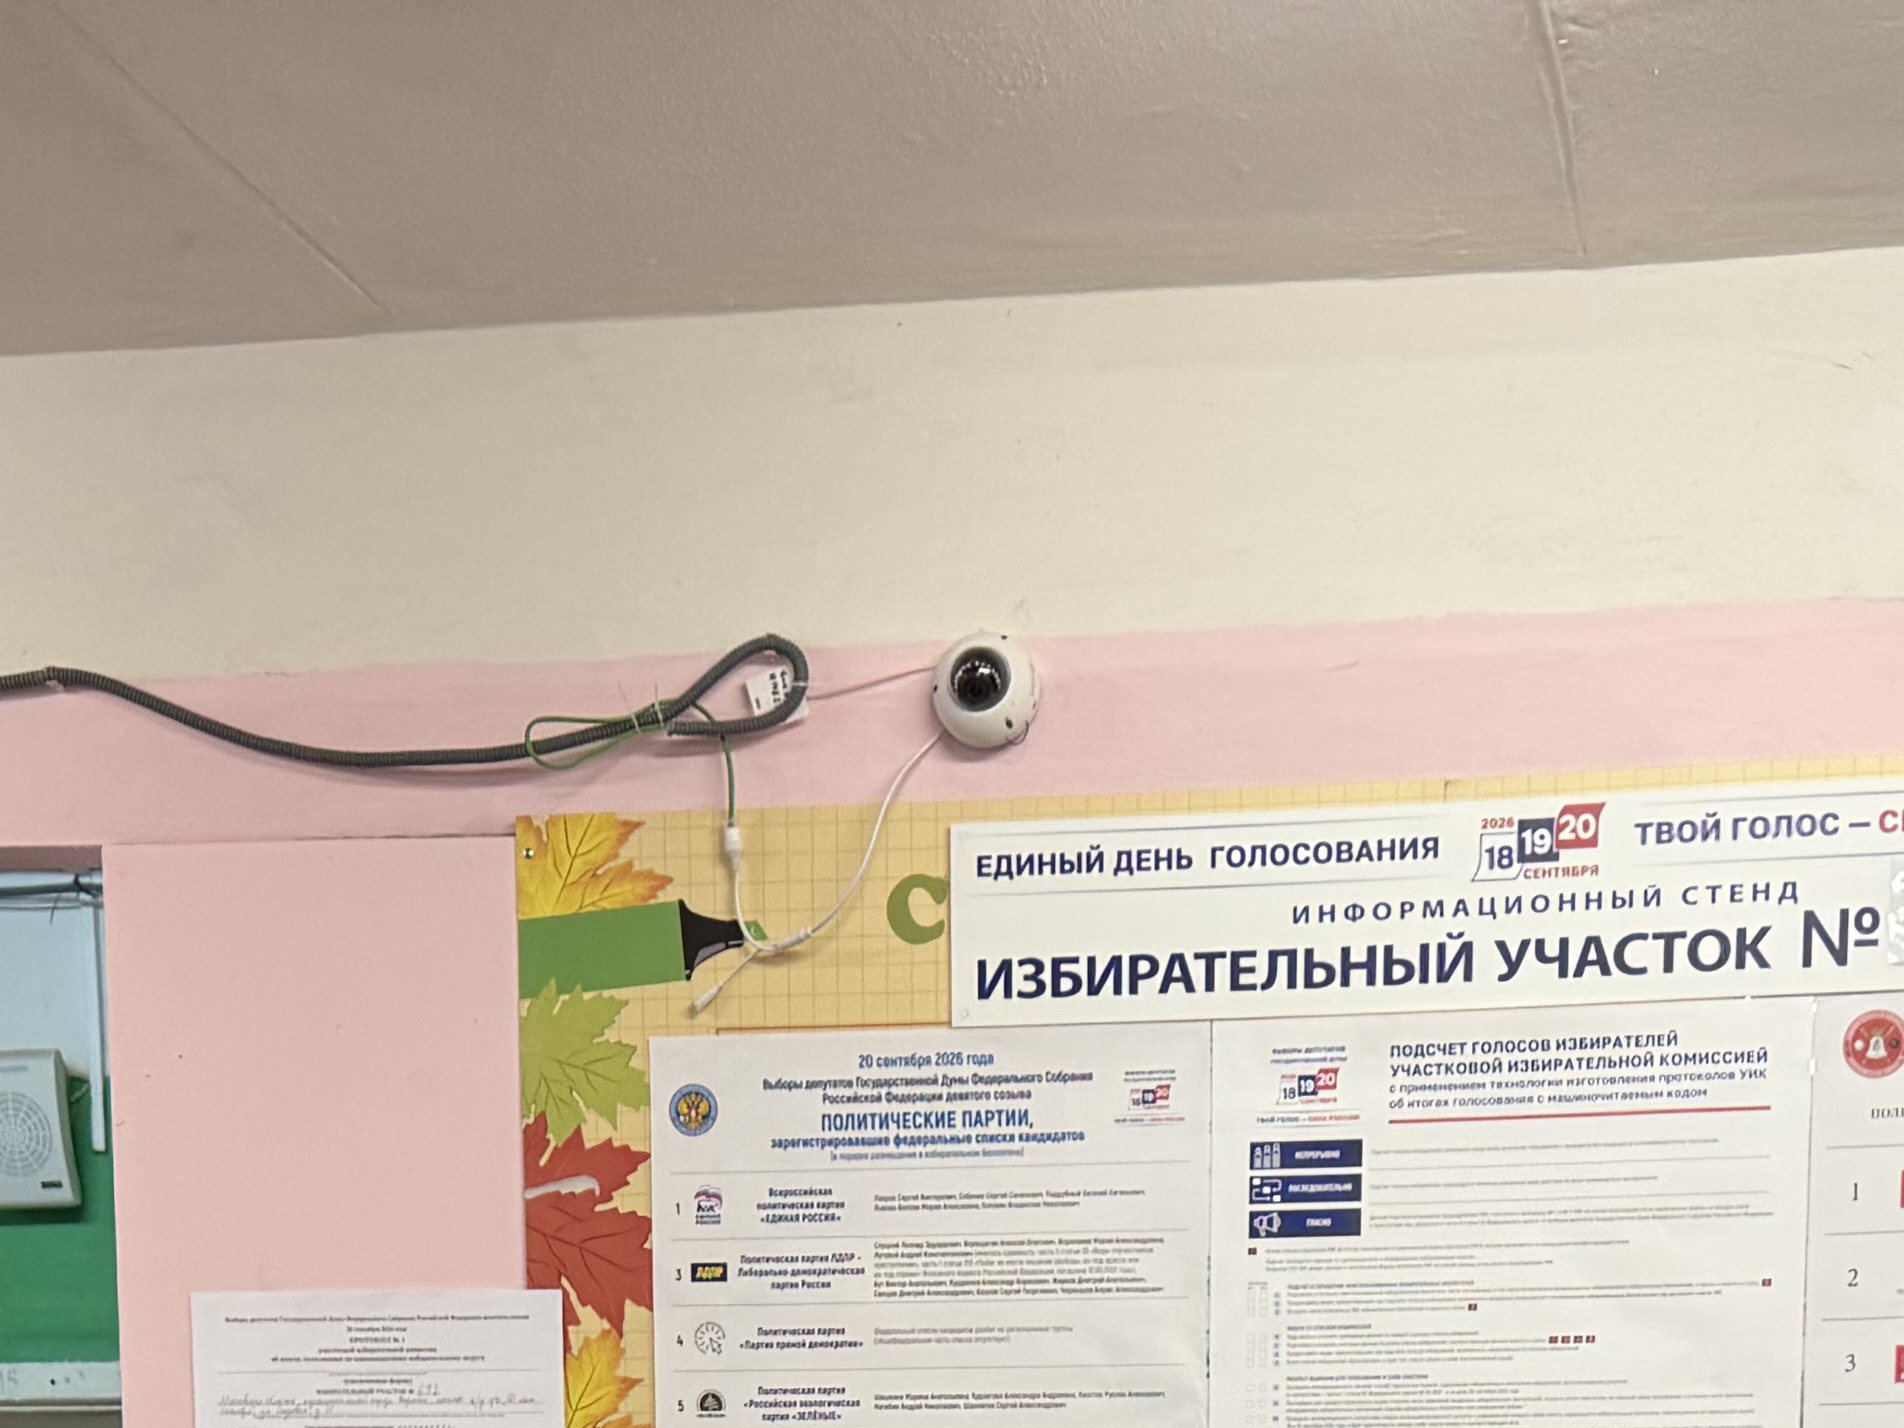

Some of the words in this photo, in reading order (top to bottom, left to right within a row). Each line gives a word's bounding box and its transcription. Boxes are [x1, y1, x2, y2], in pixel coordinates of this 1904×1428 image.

[1481, 817, 1515, 831] 2026
[1633, 812, 1720, 844] ТВОЙ
[1731, 812, 1839, 839] ГОЛОС
[1485, 843, 1514, 872] 18
[1520, 829, 1552, 856] 19
[1557, 812, 1596, 840] 20
[976, 845, 1104, 880] ЕДИНЫЙ
[1112, 848, 1193, 876] ДЕНЬ
[1210, 837, 1438, 867] ГОЛОСОВАНИЯ
[1523, 864, 1599, 881] СЕНТЯБРЯ
[1292, 886, 1661, 924] ИНФОРМАЦИОННЫЙ
[1681, 880, 1799, 907] СТЕНД
[976, 931, 1474, 1001] ИЗБИРАТЕЛЬНЫЙ
[1496, 924, 1771, 985] УЧАСТОК
[1802, 905, 1880, 968] №
[1389, 1042, 1467, 1058] ПОДСЧЕТ
[1471, 1038, 1550, 1054] ГОЛОСОВ
[1555, 1030, 1677, 1050] ИЗБИРАТЕЛЕЙ
[858, 1054, 873, 1068] 20
[875, 1053, 932, 1069] сентября
[934, 1051, 963, 1066] 2026
[966, 1053, 994, 1066] года
[1390, 1057, 1502, 1076] УЧАСТКОВОЙ
[1507, 1051, 1654, 1072] ИЗБИРАТЕЛЬНОЙ
[1659, 1047, 1767, 1066] КОМИССИЕЙ
[821, 1110, 956, 1131] ПОЛИТИЧЕСКИЕ
[961, 1108, 1033, 1128] ПАРТИИ,
[1851, 1183, 1859, 1202] 1
[675, 1202, 681, 1216] 1
[675, 1268, 683, 1281] 3
[1847, 1269, 1859, 1288] 2
[676, 1334, 684, 1348] 4
[1845, 1353, 1856, 1373] 3
[678, 1398, 684, 1412] 5
